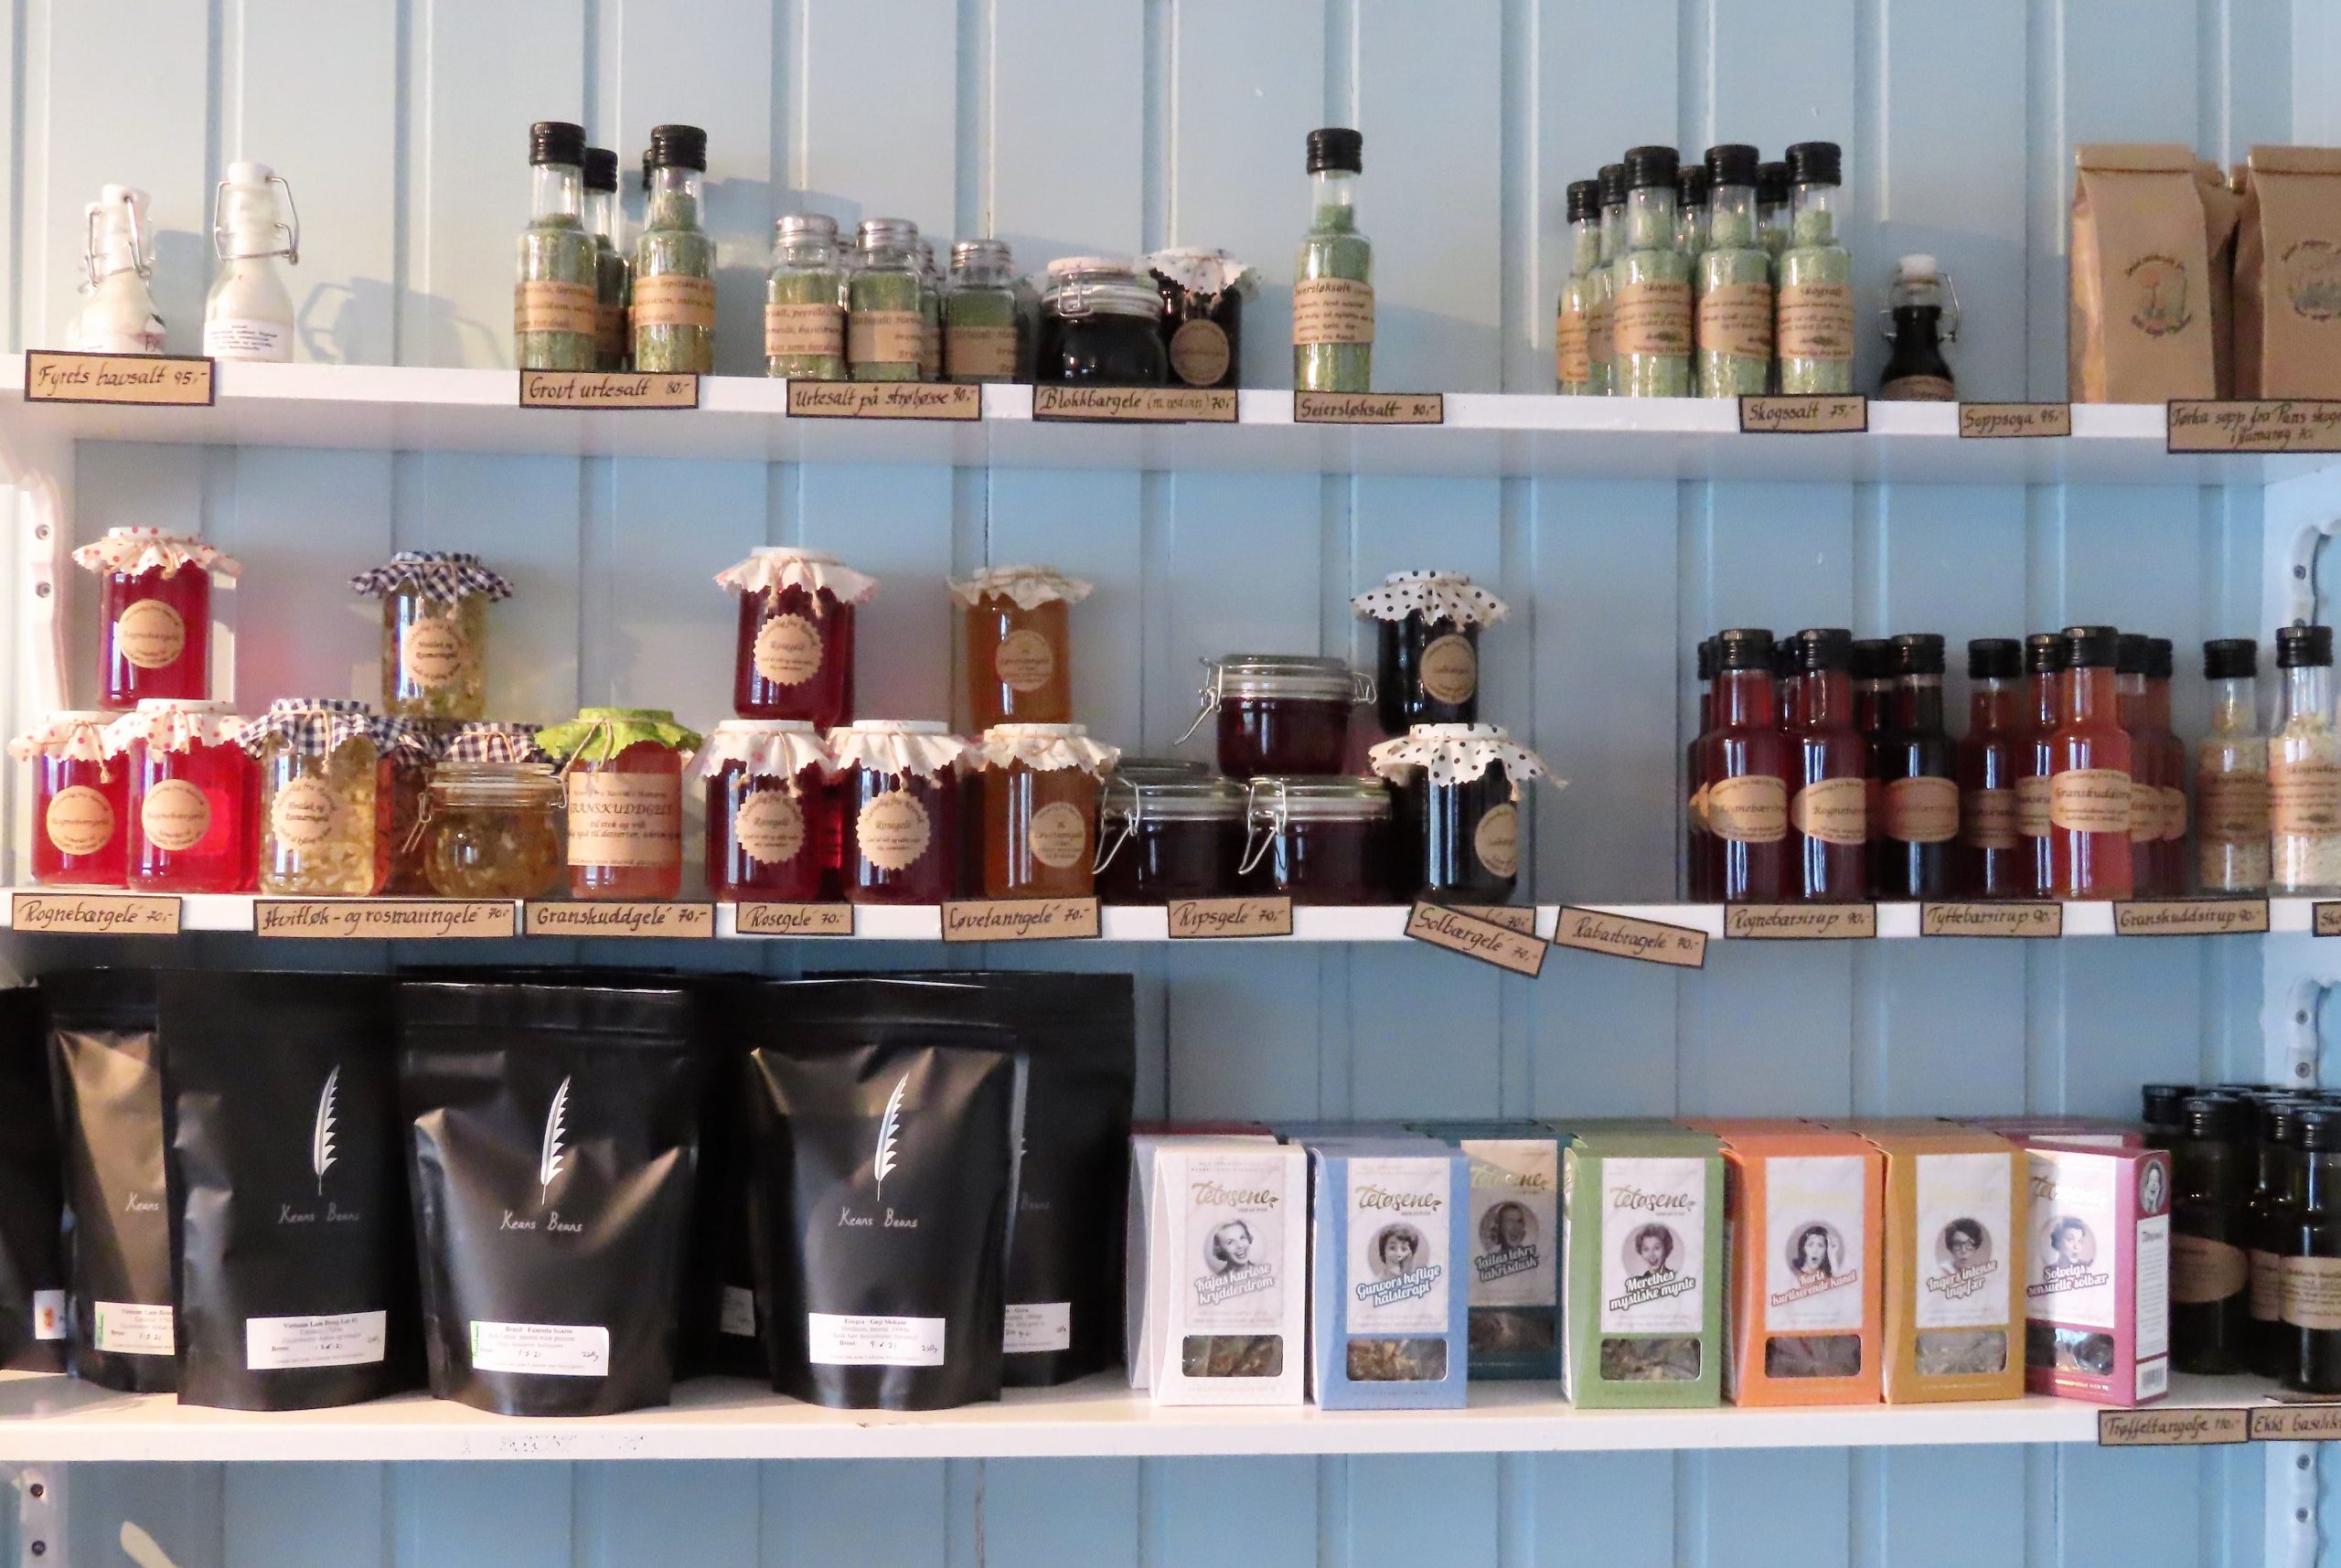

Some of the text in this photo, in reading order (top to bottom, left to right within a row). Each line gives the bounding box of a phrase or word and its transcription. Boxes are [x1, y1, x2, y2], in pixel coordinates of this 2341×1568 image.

[39, 365, 90, 396] Fyrets
[97, 361, 169, 387] havsalt
[529, 377, 574, 399] Grovt
[581, 376, 651, 398] urtesalt
[796, 385, 855, 407] Urtesalt
[856, 388, 879, 414] på
[1300, 399, 1402, 420] Seiersløksalt
[1748, 400, 1820, 430] Skogssalt
[1963, 409, 2035, 432] Soppsoya
[344, 911, 360, 935] og
[537, 905, 673, 931] Granskuddgelé
[948, 904, 1061, 934] Løvetanngelé
[1173, 901, 1256, 933] Ripsgelé
[2121, 908, 2237, 930] Granskuddsirup
[1415, 907, 1511, 952] Solbærgelé
[125, 1191, 160, 1211] Keans
[278, 1202, 359, 1223] Keans Beans
[500, 1210, 583, 1232] Keans Beans
[839, 1206, 918, 1228] Keans Beans
[1356, 1276, 1403, 1300] Gunvors
[1609, 1276, 1696, 1311] mystiske mynte
[1625, 1270, 1675, 1294] Merethes
